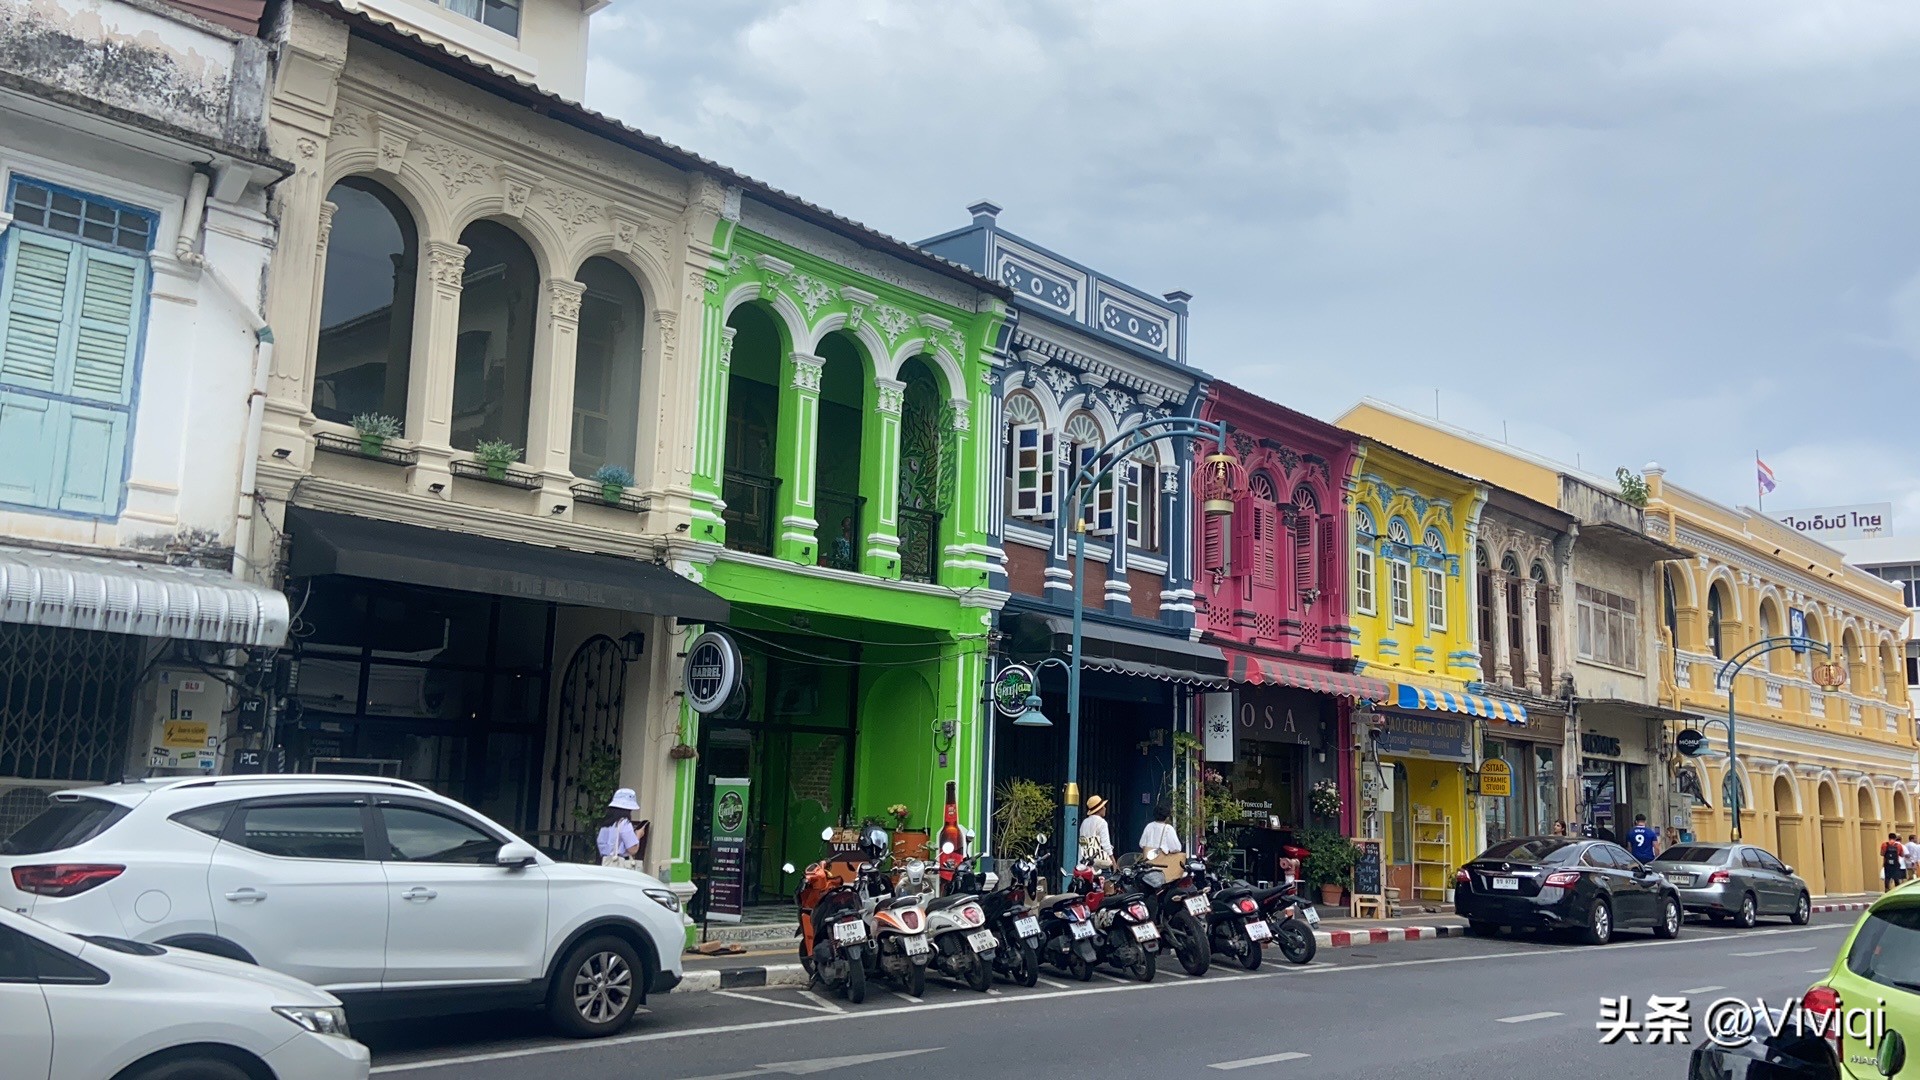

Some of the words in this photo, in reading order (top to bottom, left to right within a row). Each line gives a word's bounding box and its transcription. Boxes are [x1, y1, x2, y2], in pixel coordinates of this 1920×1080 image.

[1850, 511, 1882, 527] ไทย
[692, 667, 721, 678] BARREL
[1403, 719, 1435, 736] CERAMIC
[1436, 722, 1461, 739] STUDIO
[1483, 776, 1507, 784] CERAMIC
[1264, 801, 1273, 809] Bar
[1071, 818, 1077, 826] 2
[1635, 834, 1645, 847] 9
[833, 842, 861, 852] VALH
[1850, 1055, 1879, 1066] MAR
